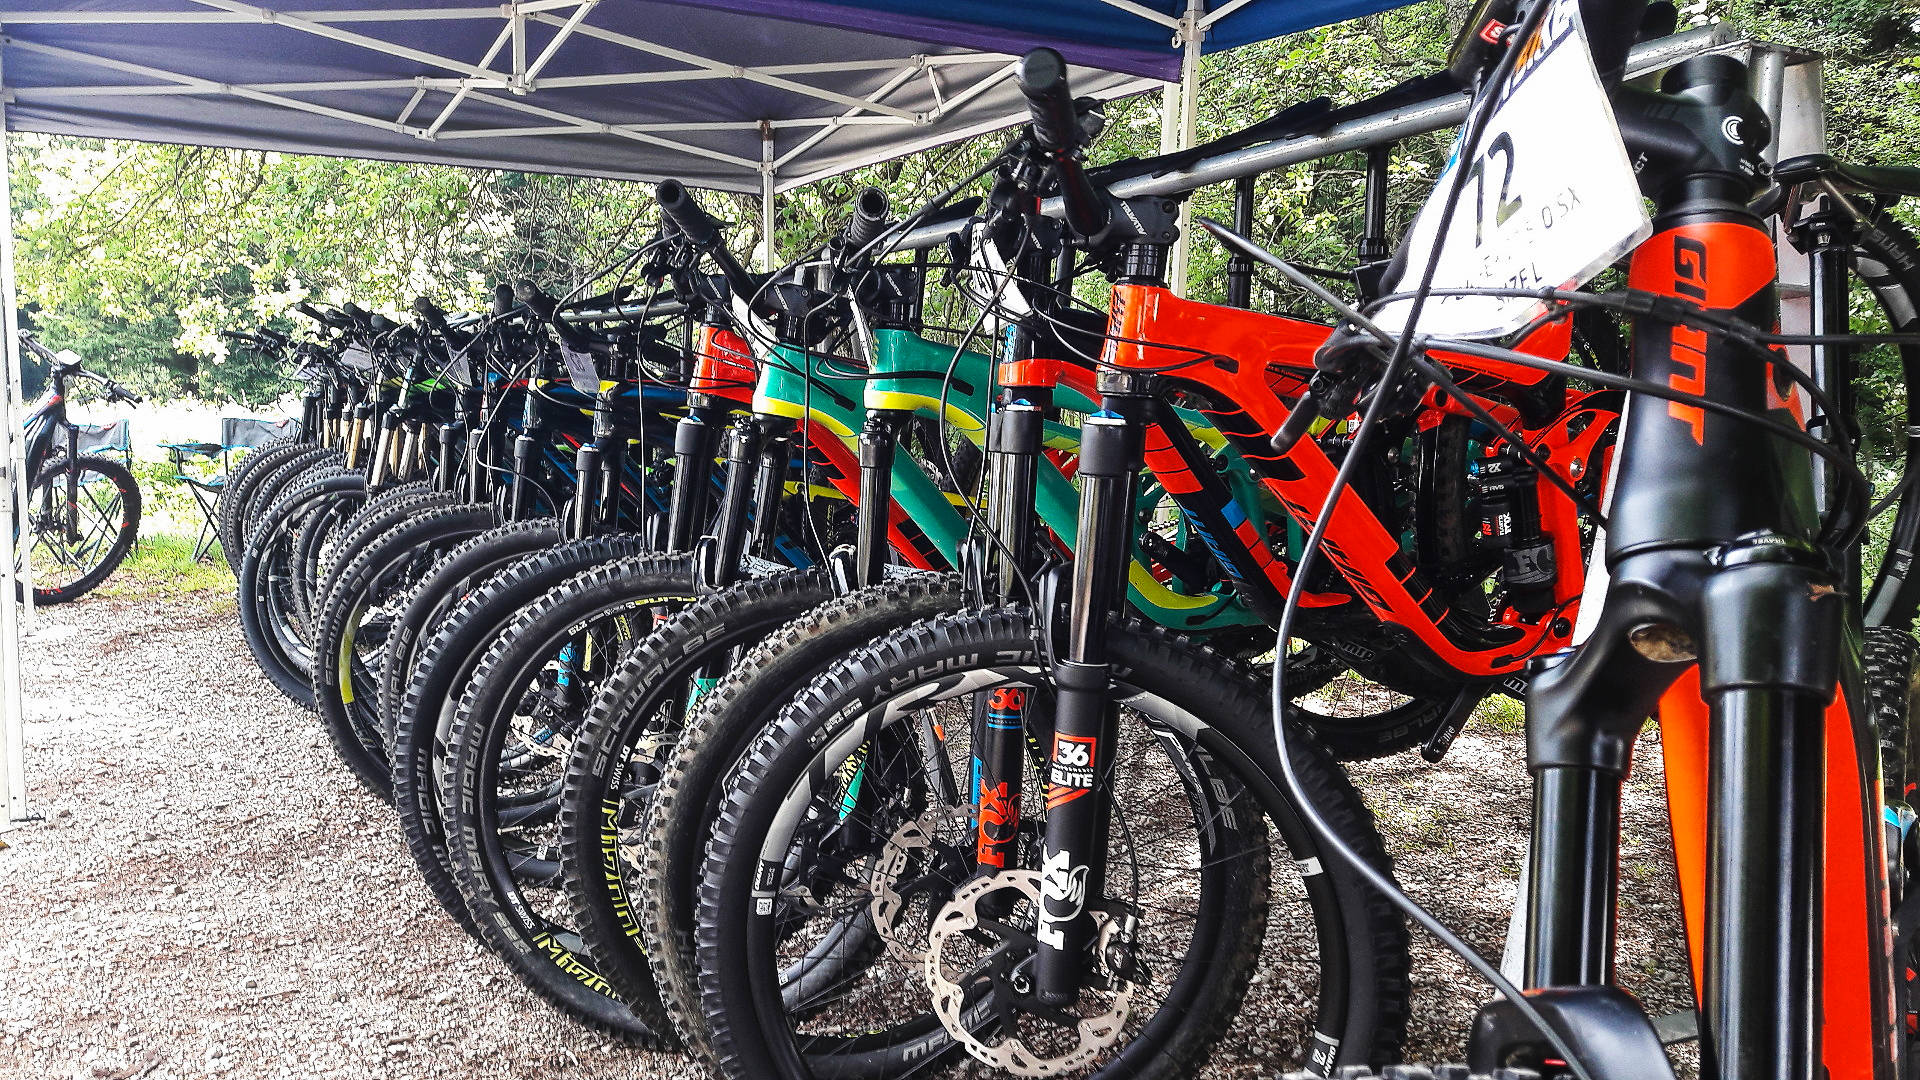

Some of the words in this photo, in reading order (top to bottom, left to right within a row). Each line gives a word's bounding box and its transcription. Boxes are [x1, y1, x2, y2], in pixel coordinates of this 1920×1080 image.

[591, 622, 726, 778] SCHWALBE
[406, 747, 438, 835] MAGIC
[461, 723, 485, 816] MAGIC
[610, 762, 625, 790] SWISS
[620, 744, 631, 762] DT
[1050, 767, 1094, 788] ELITE
[1057, 740, 1090, 767] 36
[977, 777, 1021, 869] FOX
[463, 825, 500, 908] MARY
[1037, 844, 1090, 951] FOX
[515, 904, 536, 930] SWISS
